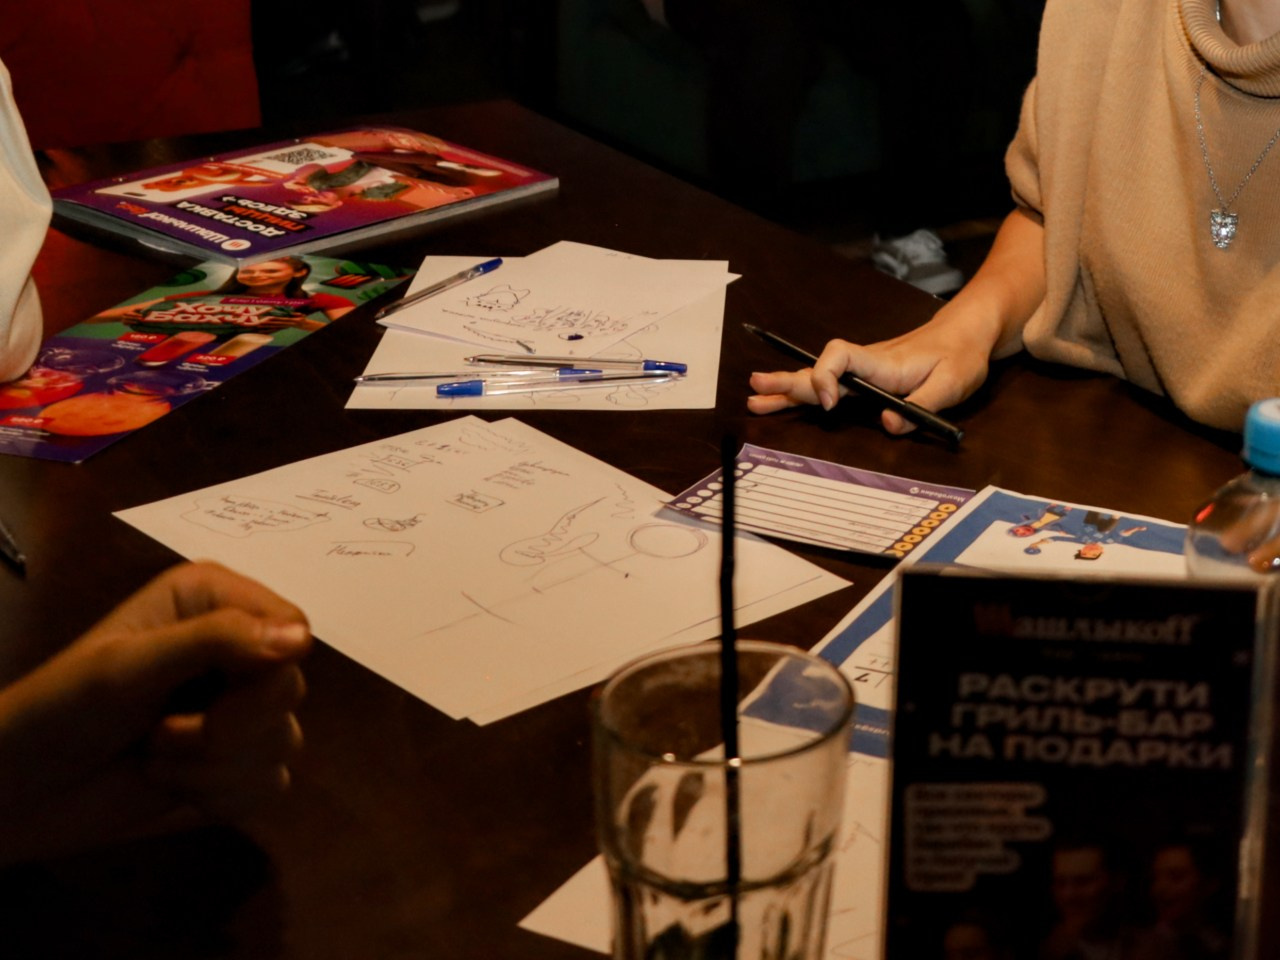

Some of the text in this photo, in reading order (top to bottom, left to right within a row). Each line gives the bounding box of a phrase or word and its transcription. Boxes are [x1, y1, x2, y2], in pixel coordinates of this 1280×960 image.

[175, 200, 286, 239] ДОСТАВКА
[956, 671, 1212, 710] РАСКРУТИ
[949, 701, 1216, 739] ГРИЛЬ-БАР
[926, 731, 994, 762] НА
[1002, 733, 1236, 771] ПОДАРКИ
